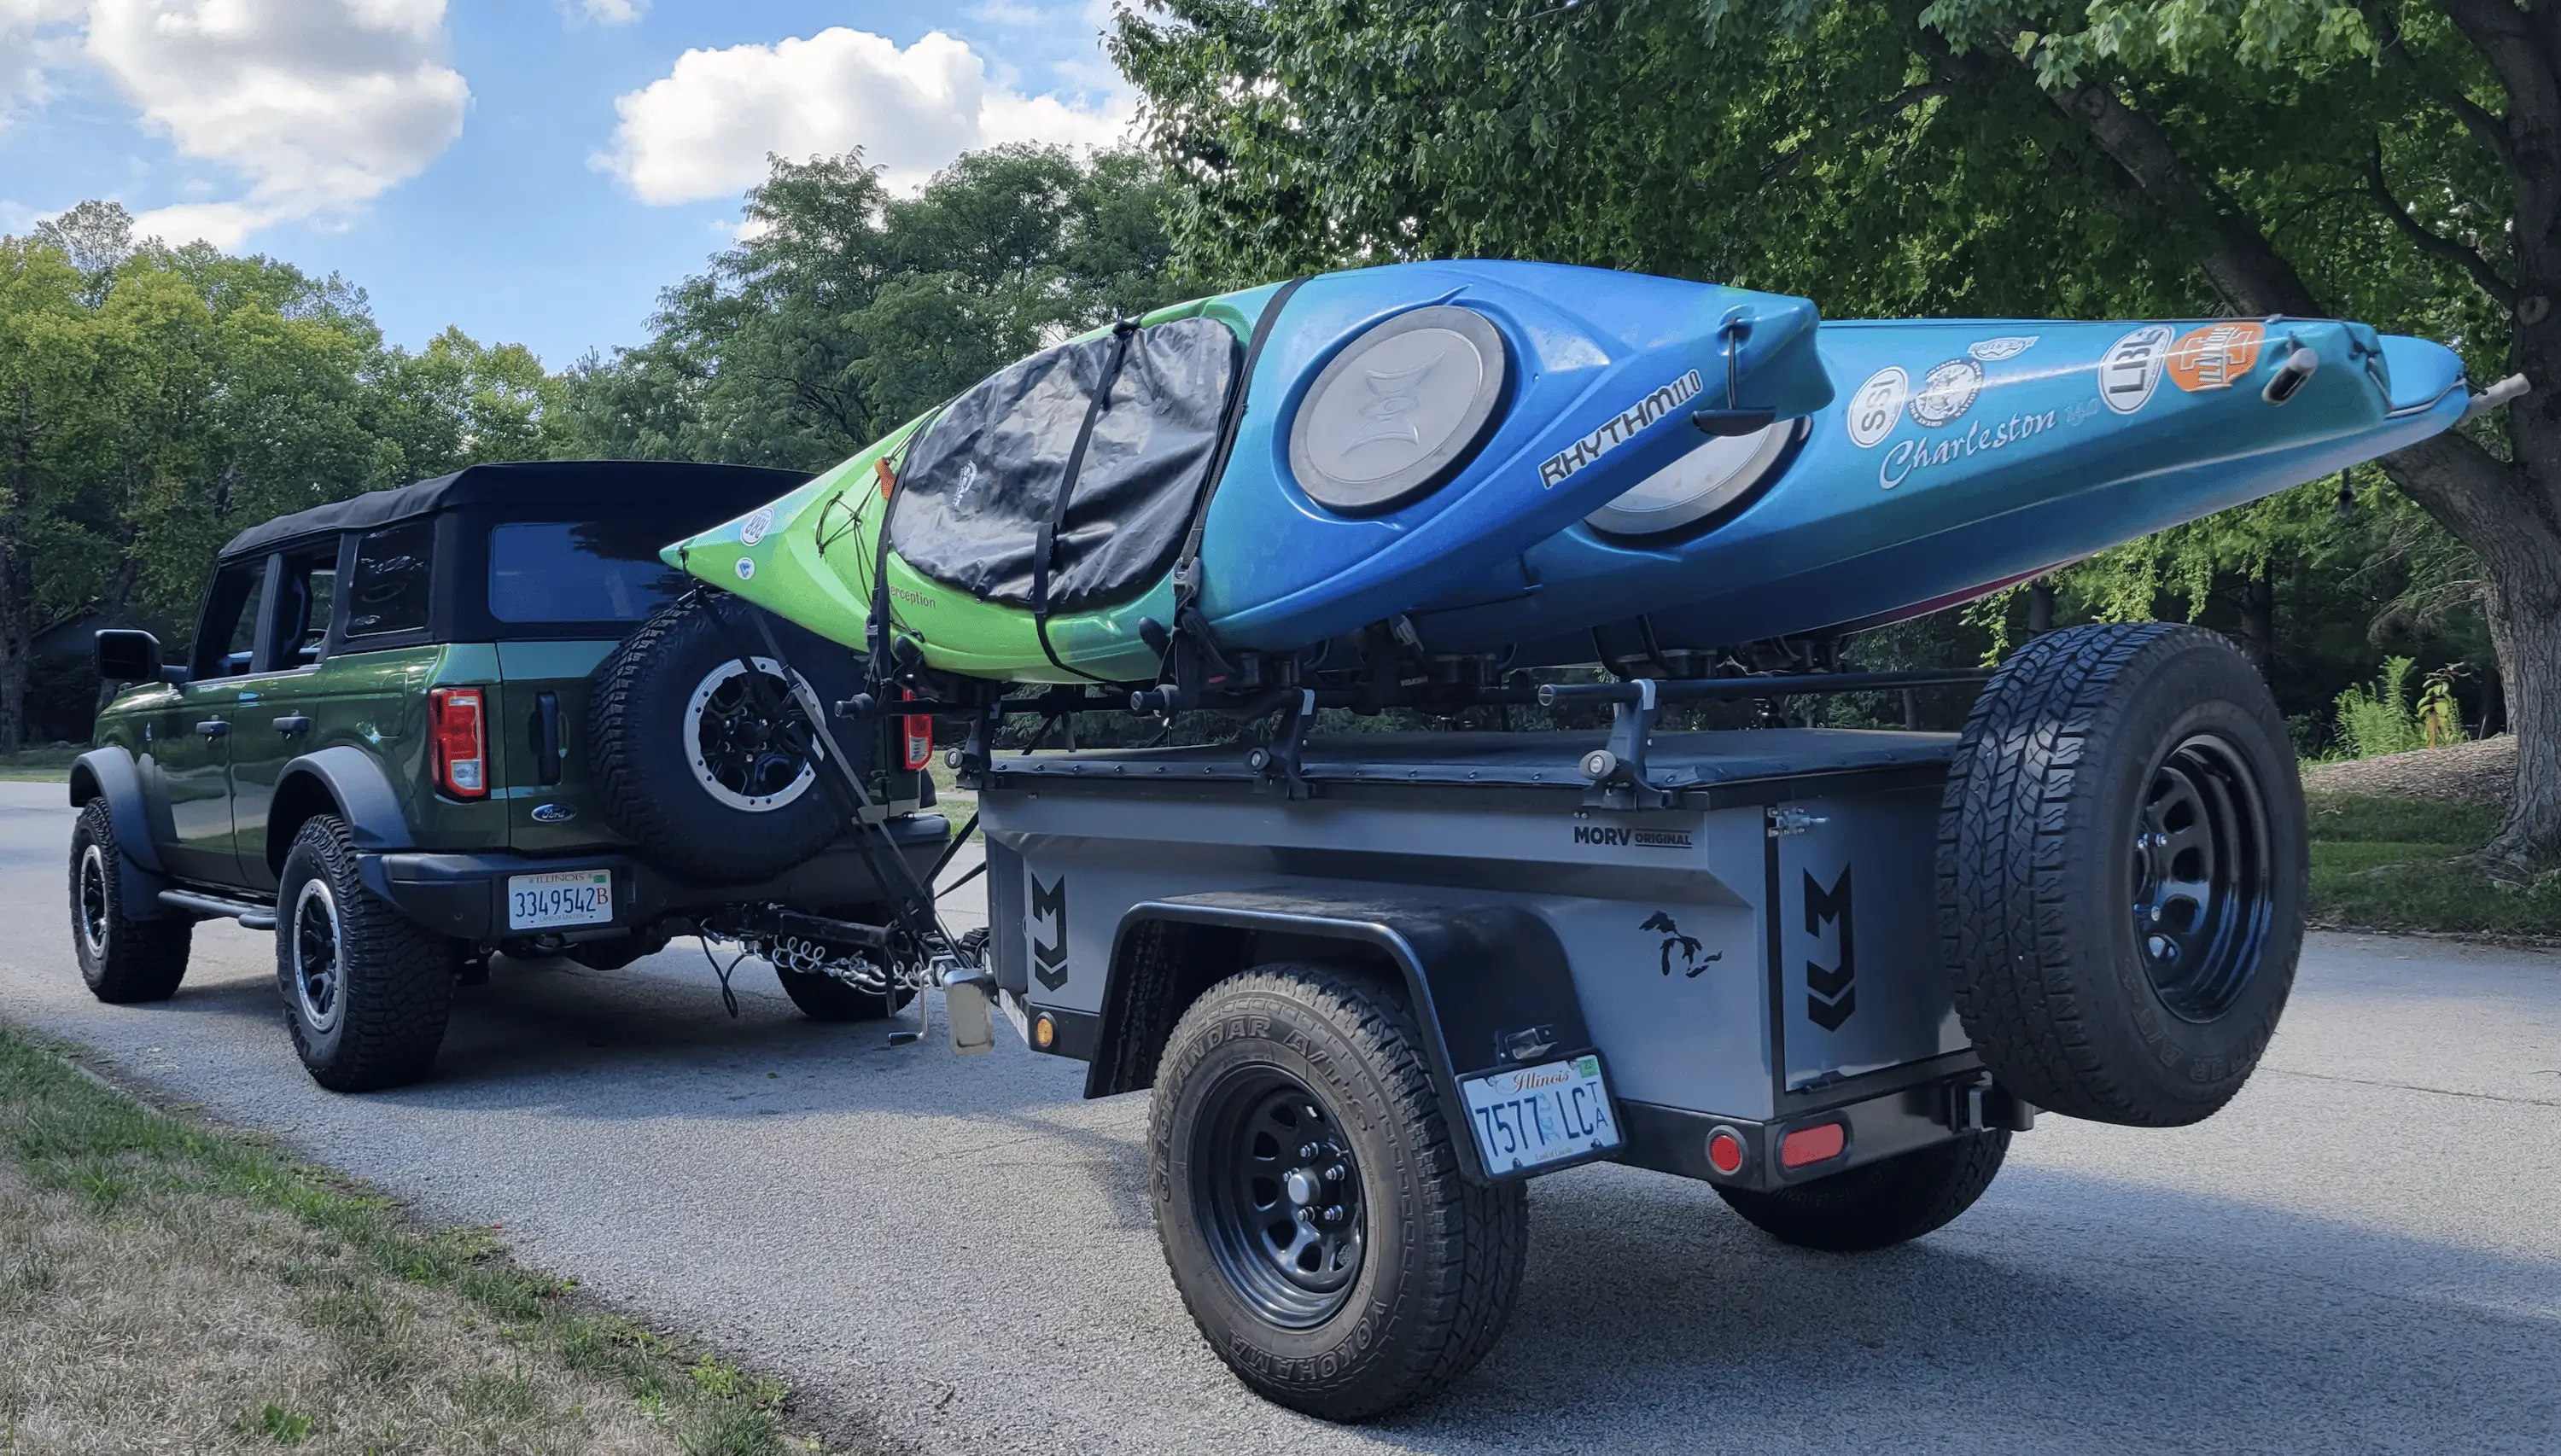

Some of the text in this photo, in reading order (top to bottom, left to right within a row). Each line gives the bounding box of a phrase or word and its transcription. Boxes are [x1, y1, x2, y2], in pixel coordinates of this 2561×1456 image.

[2198, 327, 2236, 383] ILLINOIS
[1539, 370, 1702, 488] RHYTHM 11.0
[1861, 378, 1896, 433] SSI
[1879, 408, 2057, 490] Charleston
[890, 585, 936, 609] erception
[541, 808, 566, 819] Ford
[1573, 826, 1693, 846] MORV ORIGINAL
[536, 873, 585, 884] ILLINOIS
[1155, 1014, 1273, 1202] GEOLANDAR
[1508, 1069, 1571, 1095] Illinois
[1474, 1086, 1595, 1158] 7577 LC
[1229, 1296, 1388, 1382] YOKOHAMA
